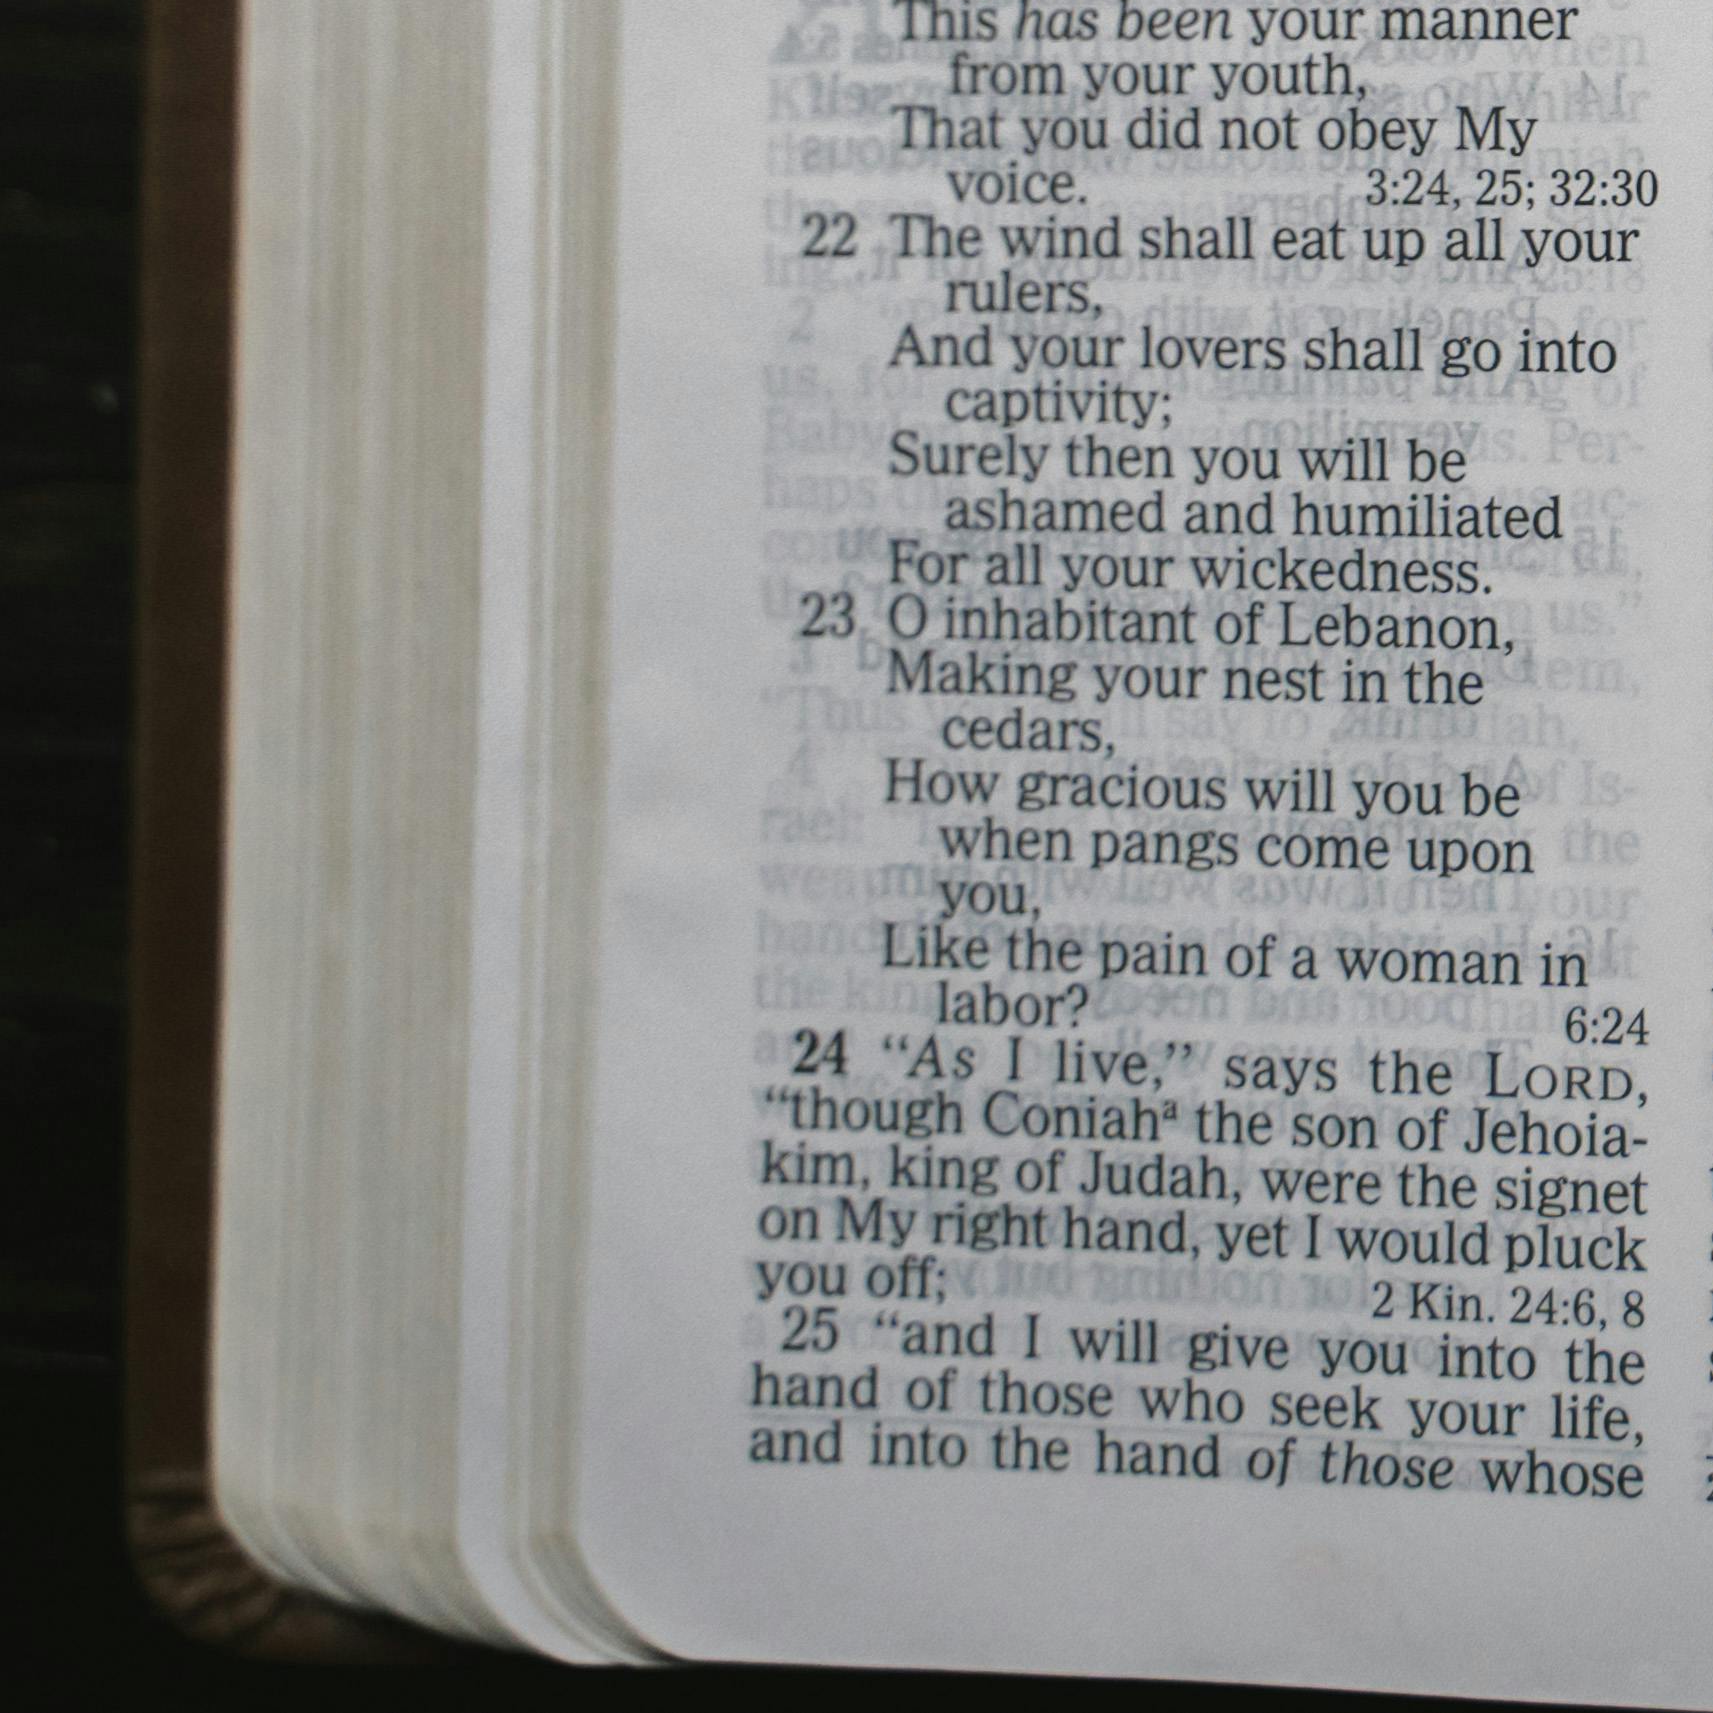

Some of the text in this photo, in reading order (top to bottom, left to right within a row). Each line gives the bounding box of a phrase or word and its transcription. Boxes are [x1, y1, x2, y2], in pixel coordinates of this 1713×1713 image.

[947, 164, 1087, 206] voice.
[1364, 168, 1660, 212] 3:24, 25; 32:30
[800, 212, 1641, 271] 22 The wind shall eat up all your
[1563, 1006, 1650, 1047] 6:24
[760, 1140, 1649, 1219] kim, king of Judah, were the signet
[755, 1254, 948, 1308] you off;
[1371, 1281, 1647, 1331] 2 Kin. 24:6, 8
